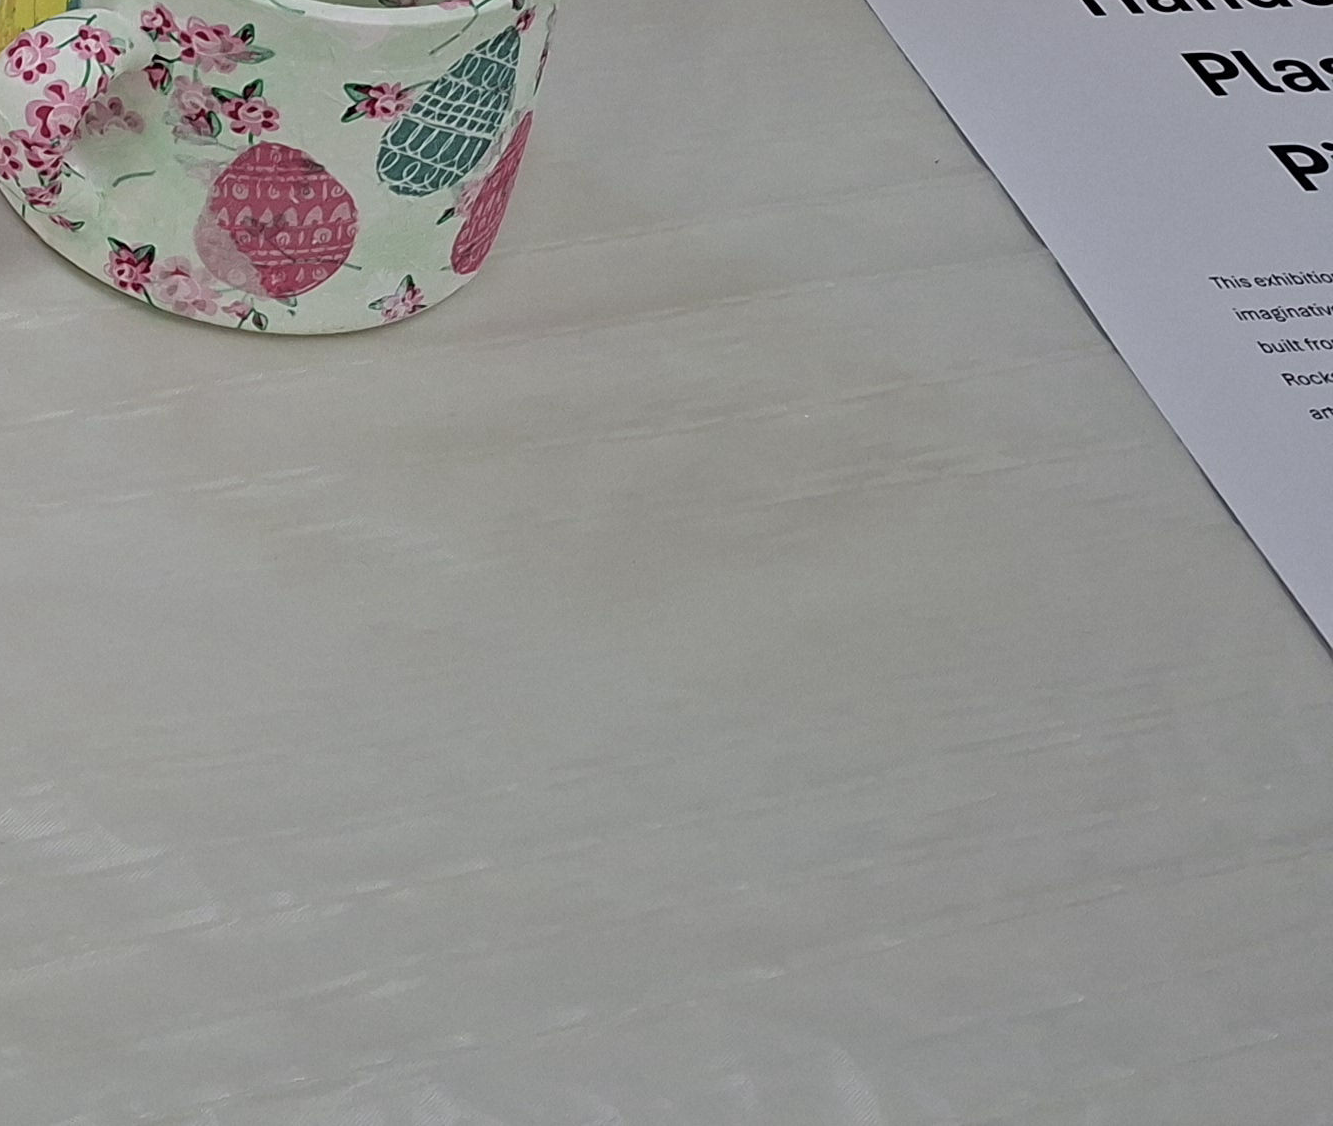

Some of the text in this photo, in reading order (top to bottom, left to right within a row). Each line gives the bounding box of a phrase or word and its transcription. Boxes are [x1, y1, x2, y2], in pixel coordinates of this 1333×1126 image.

[1208, 271, 1333, 289] This exhibitio
[1232, 303, 1333, 323] imaginativ
[1257, 338, 1333, 354] built fro
[1280, 371, 1333, 387] Rock
